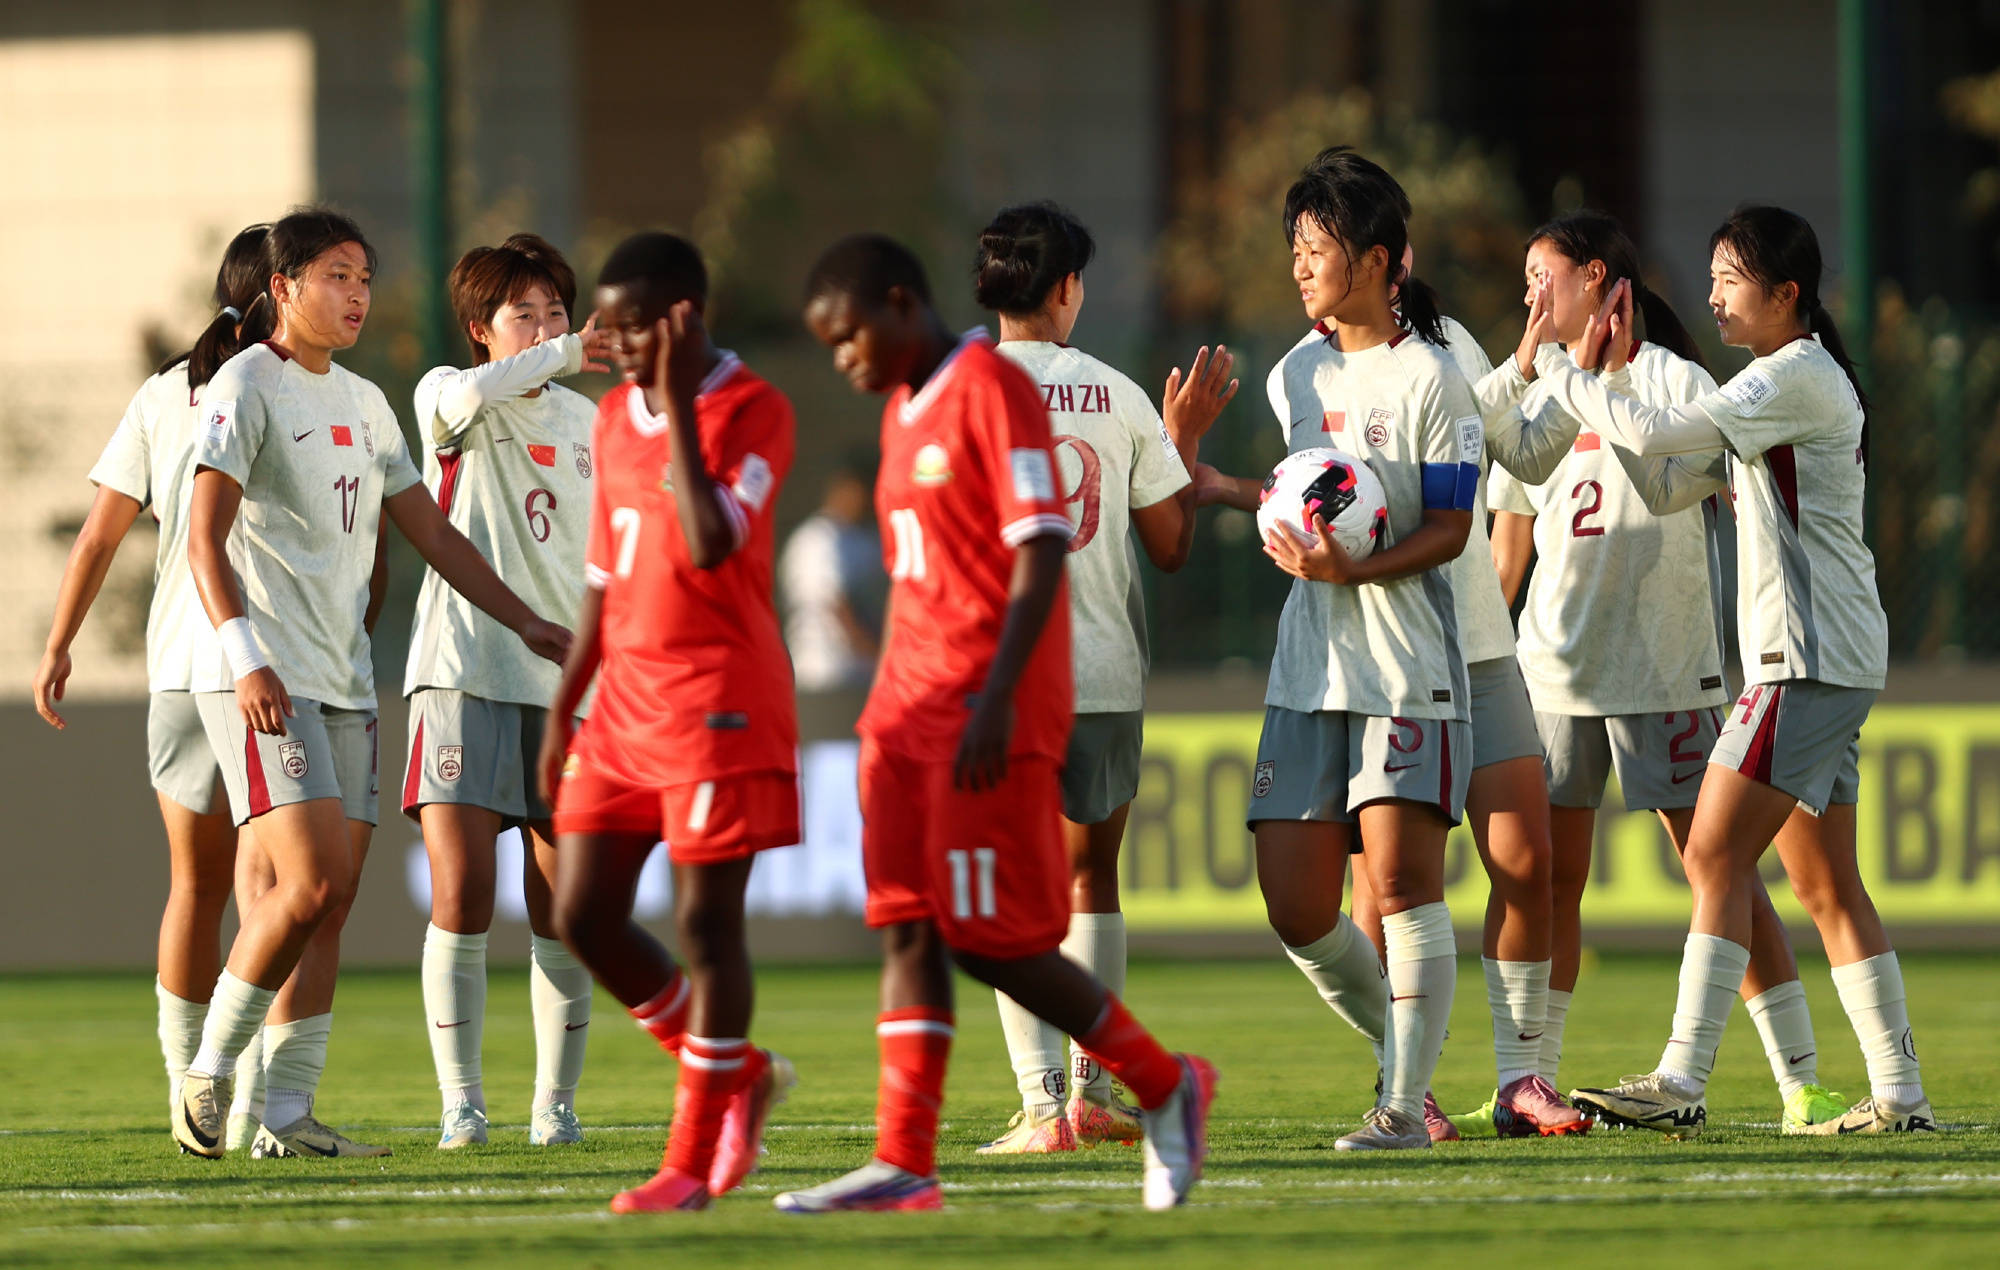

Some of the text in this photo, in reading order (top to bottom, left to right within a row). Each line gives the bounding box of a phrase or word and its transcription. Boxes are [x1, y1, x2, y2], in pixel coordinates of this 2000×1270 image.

[333, 474, 361, 535] 11
[525, 487, 557, 543] 6
[1571, 479, 1605, 538] 2
[610, 506, 641, 580] 7
[1664, 709, 1704, 764] 2
[946, 847, 997, 919] 11
